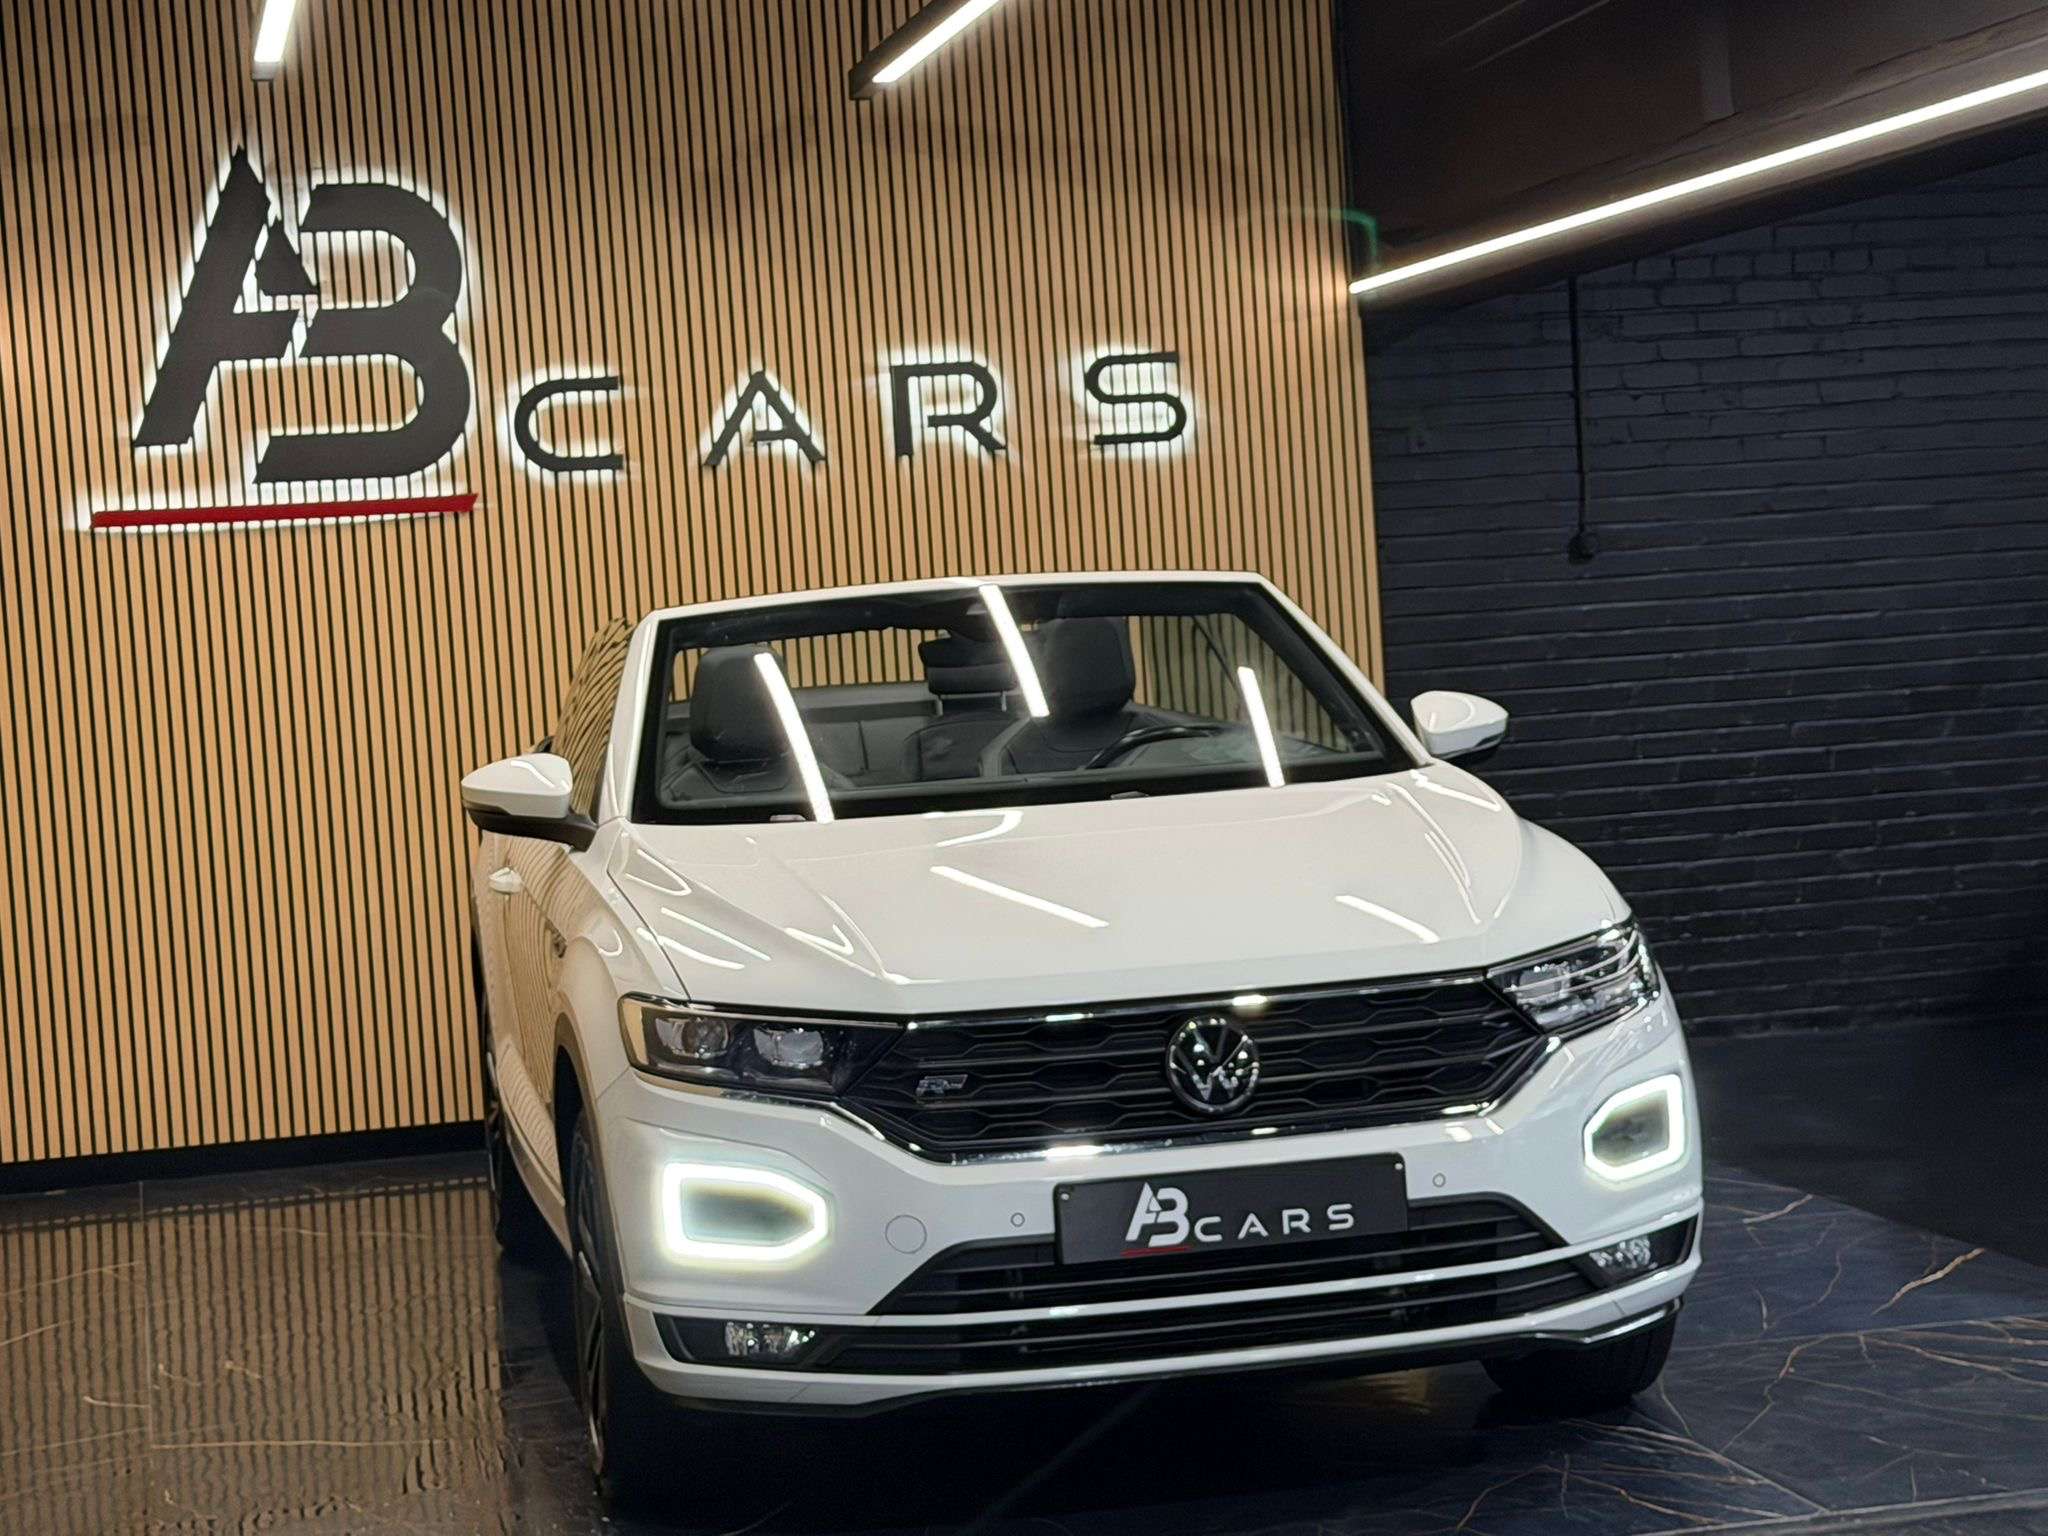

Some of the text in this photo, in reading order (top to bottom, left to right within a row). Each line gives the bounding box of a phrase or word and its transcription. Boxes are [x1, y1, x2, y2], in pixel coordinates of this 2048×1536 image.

[132, 146, 1187, 484] AB CARS
[1125, 1181, 1355, 1248] AB CARS
